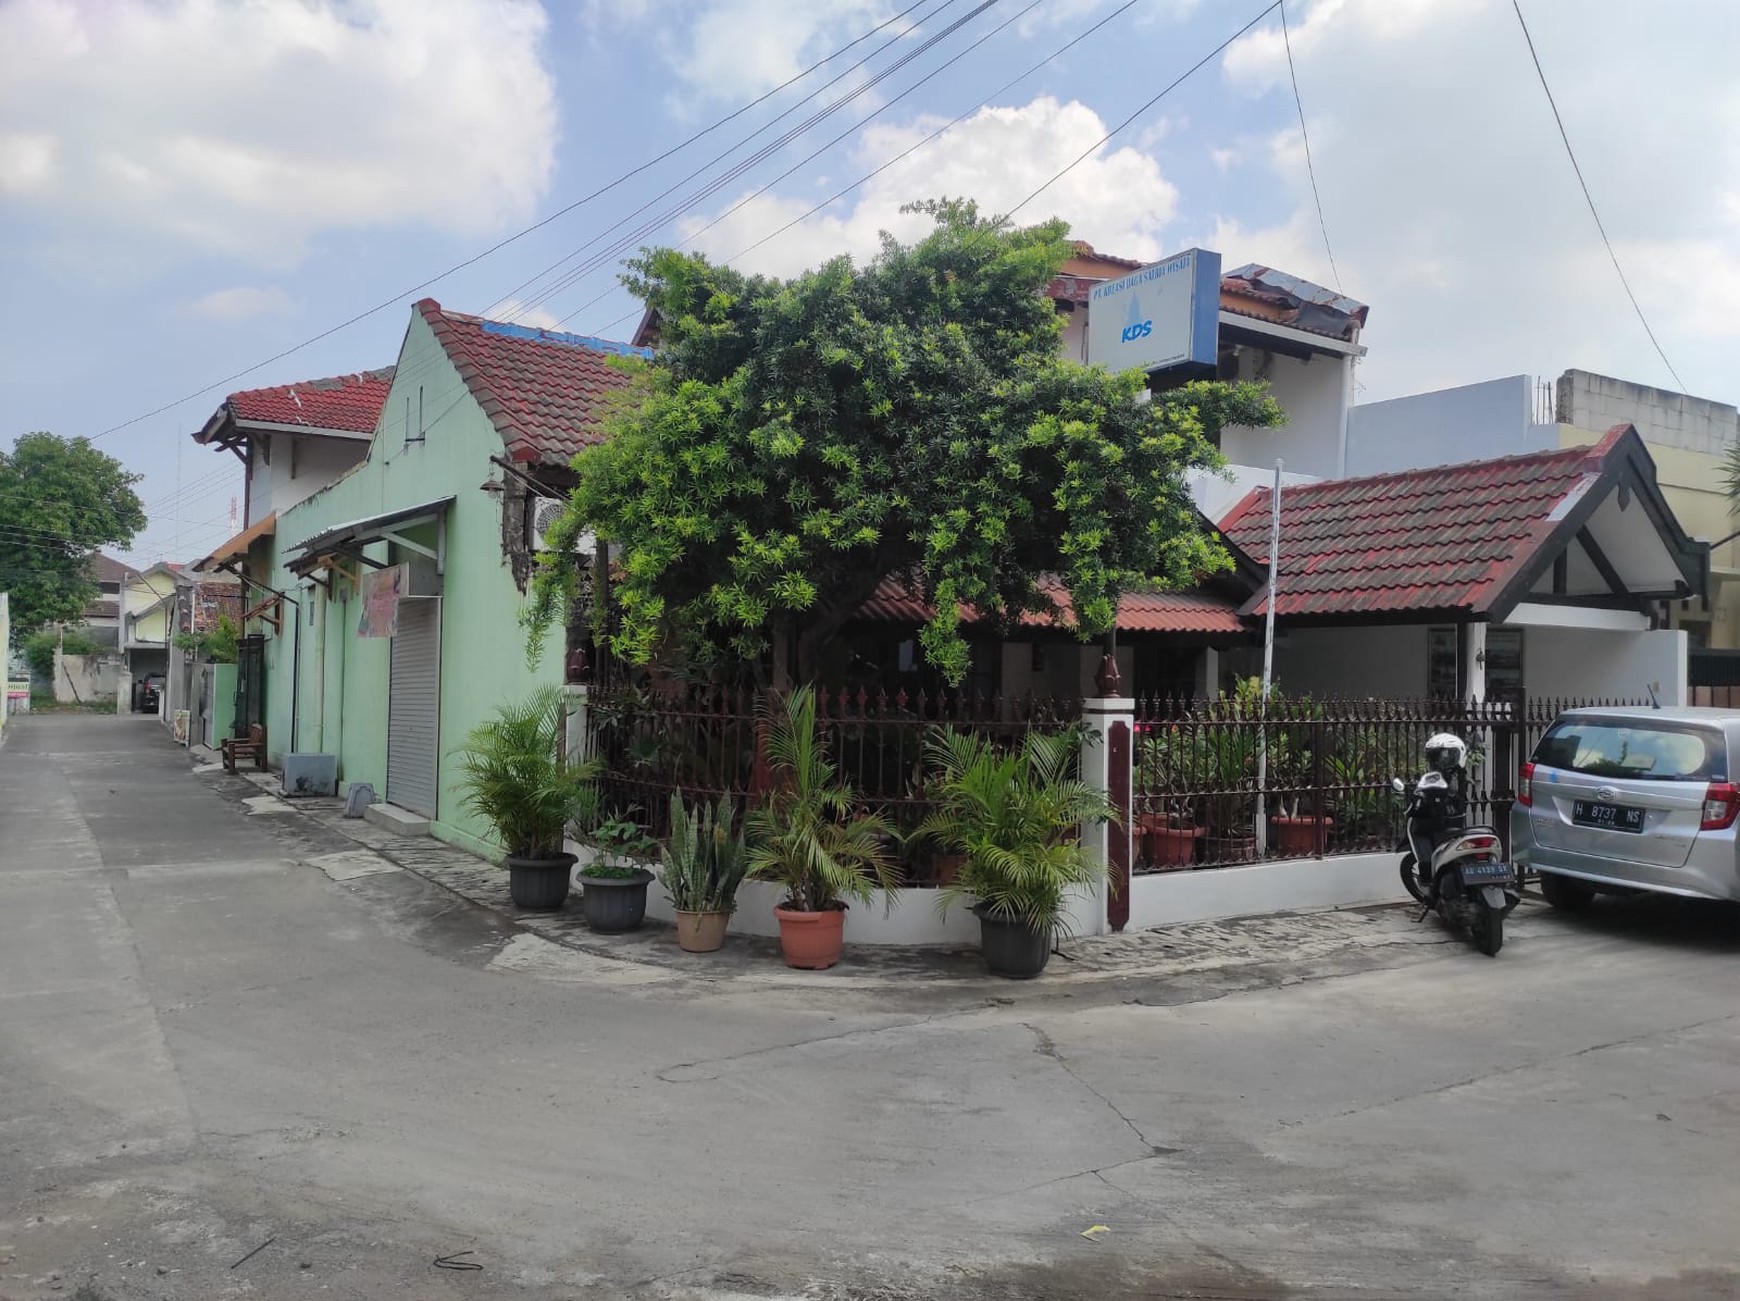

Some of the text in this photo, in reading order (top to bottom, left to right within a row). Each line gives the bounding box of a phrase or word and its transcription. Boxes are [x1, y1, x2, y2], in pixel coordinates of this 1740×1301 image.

[1122, 320, 1152, 343] KDS
[1576, 803, 1584, 815] H
[1592, 806, 1616, 819] 8737
[1627, 810, 1640, 823] NS
